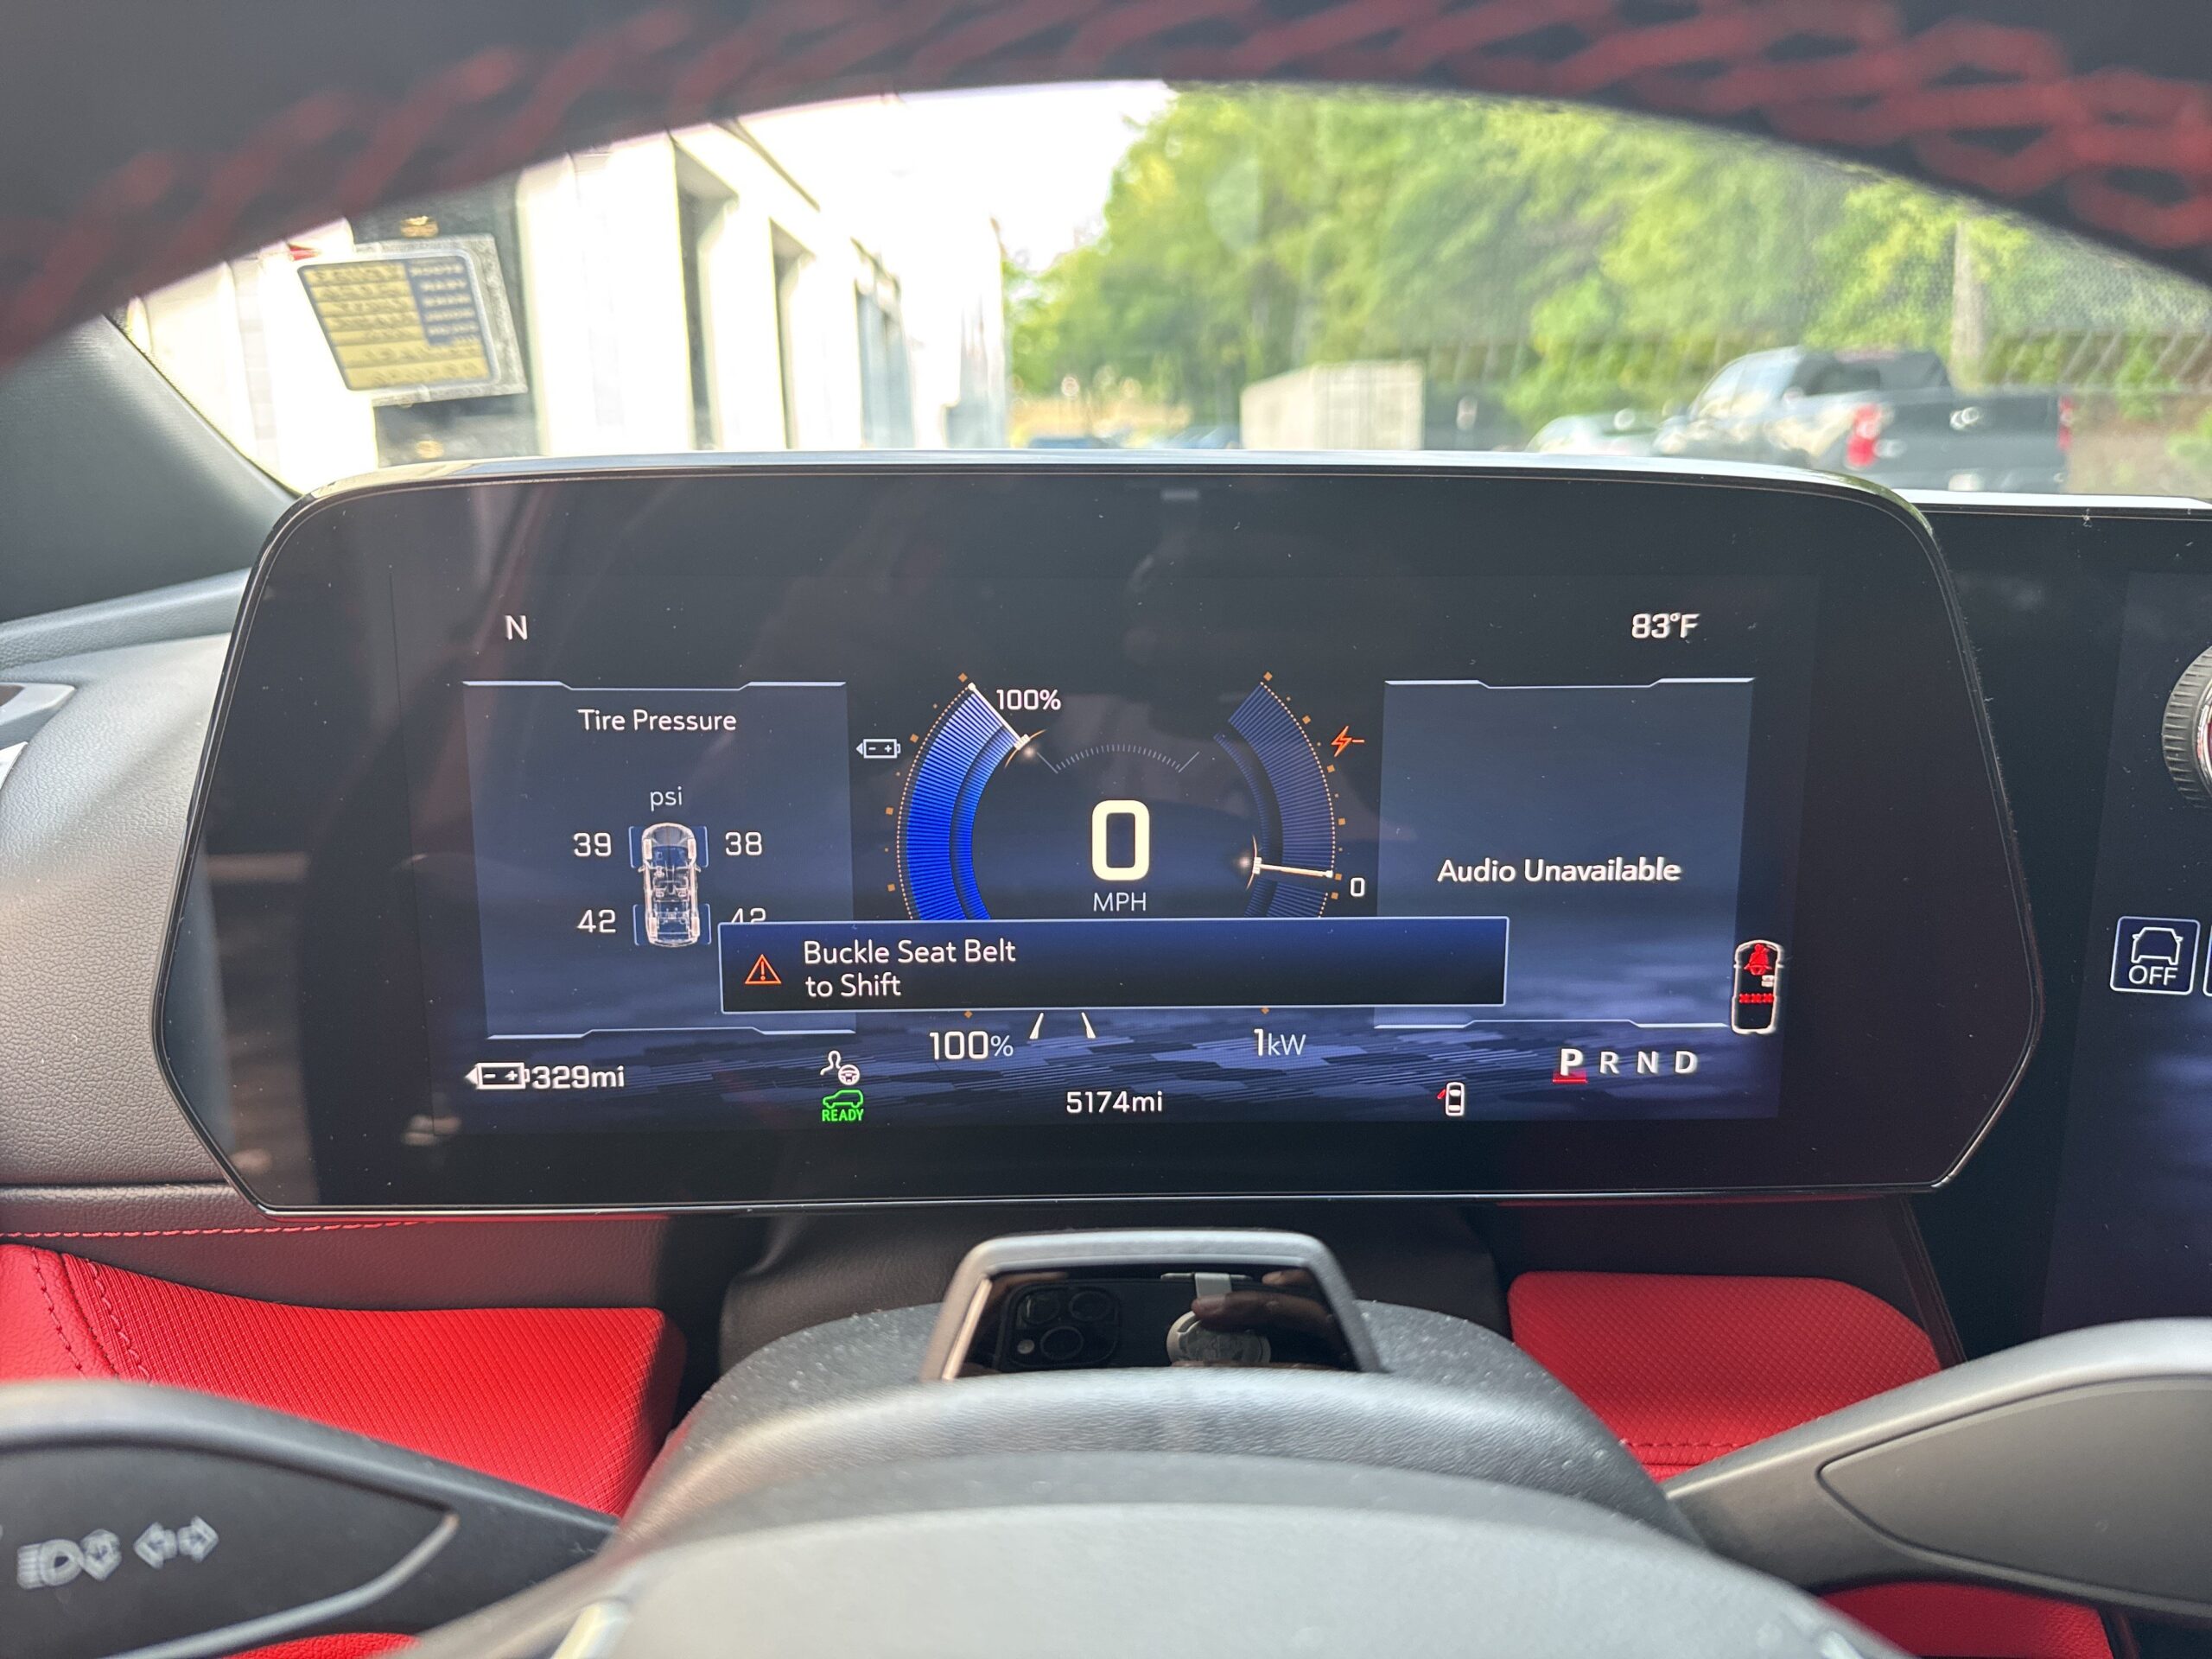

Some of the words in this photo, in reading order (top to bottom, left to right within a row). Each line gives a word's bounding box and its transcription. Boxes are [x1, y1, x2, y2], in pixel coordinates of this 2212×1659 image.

[505, 614, 528, 640] N
[1630, 612, 1700, 639] 83°F
[995, 688, 1062, 711] 100%
[578, 709, 626, 731] Tire
[633, 709, 737, 731] Pressure
[649, 786, 683, 811] psi
[572, 833, 612, 858] 39
[724, 831, 763, 855] 38
[1091, 799, 1150, 881] 0
[1437, 858, 1515, 883] Audio
[1523, 856, 1681, 883] Unavailable
[1349, 876, 1366, 898] 0
[1092, 891, 1147, 912] MPH
[576, 910, 617, 933] 42
[804, 940, 888, 964] Buckle
[898, 939, 957, 963] Seat
[965, 938, 1016, 963] Belt
[805, 976, 832, 998] to
[841, 972, 902, 997] Shift
[2128, 965, 2177, 986] OFF
[929, 1031, 1014, 1061] 100%
[1560, 1049, 1584, 1077] P
[1599, 1051, 1619, 1074] R
[1637, 1051, 1659, 1074] N
[1675, 1050, 1699, 1074] D
[531, 1065, 625, 1089] 329mi
[822, 1106, 864, 1122] READY
[1065, 1091, 1164, 1115] 5174mi
